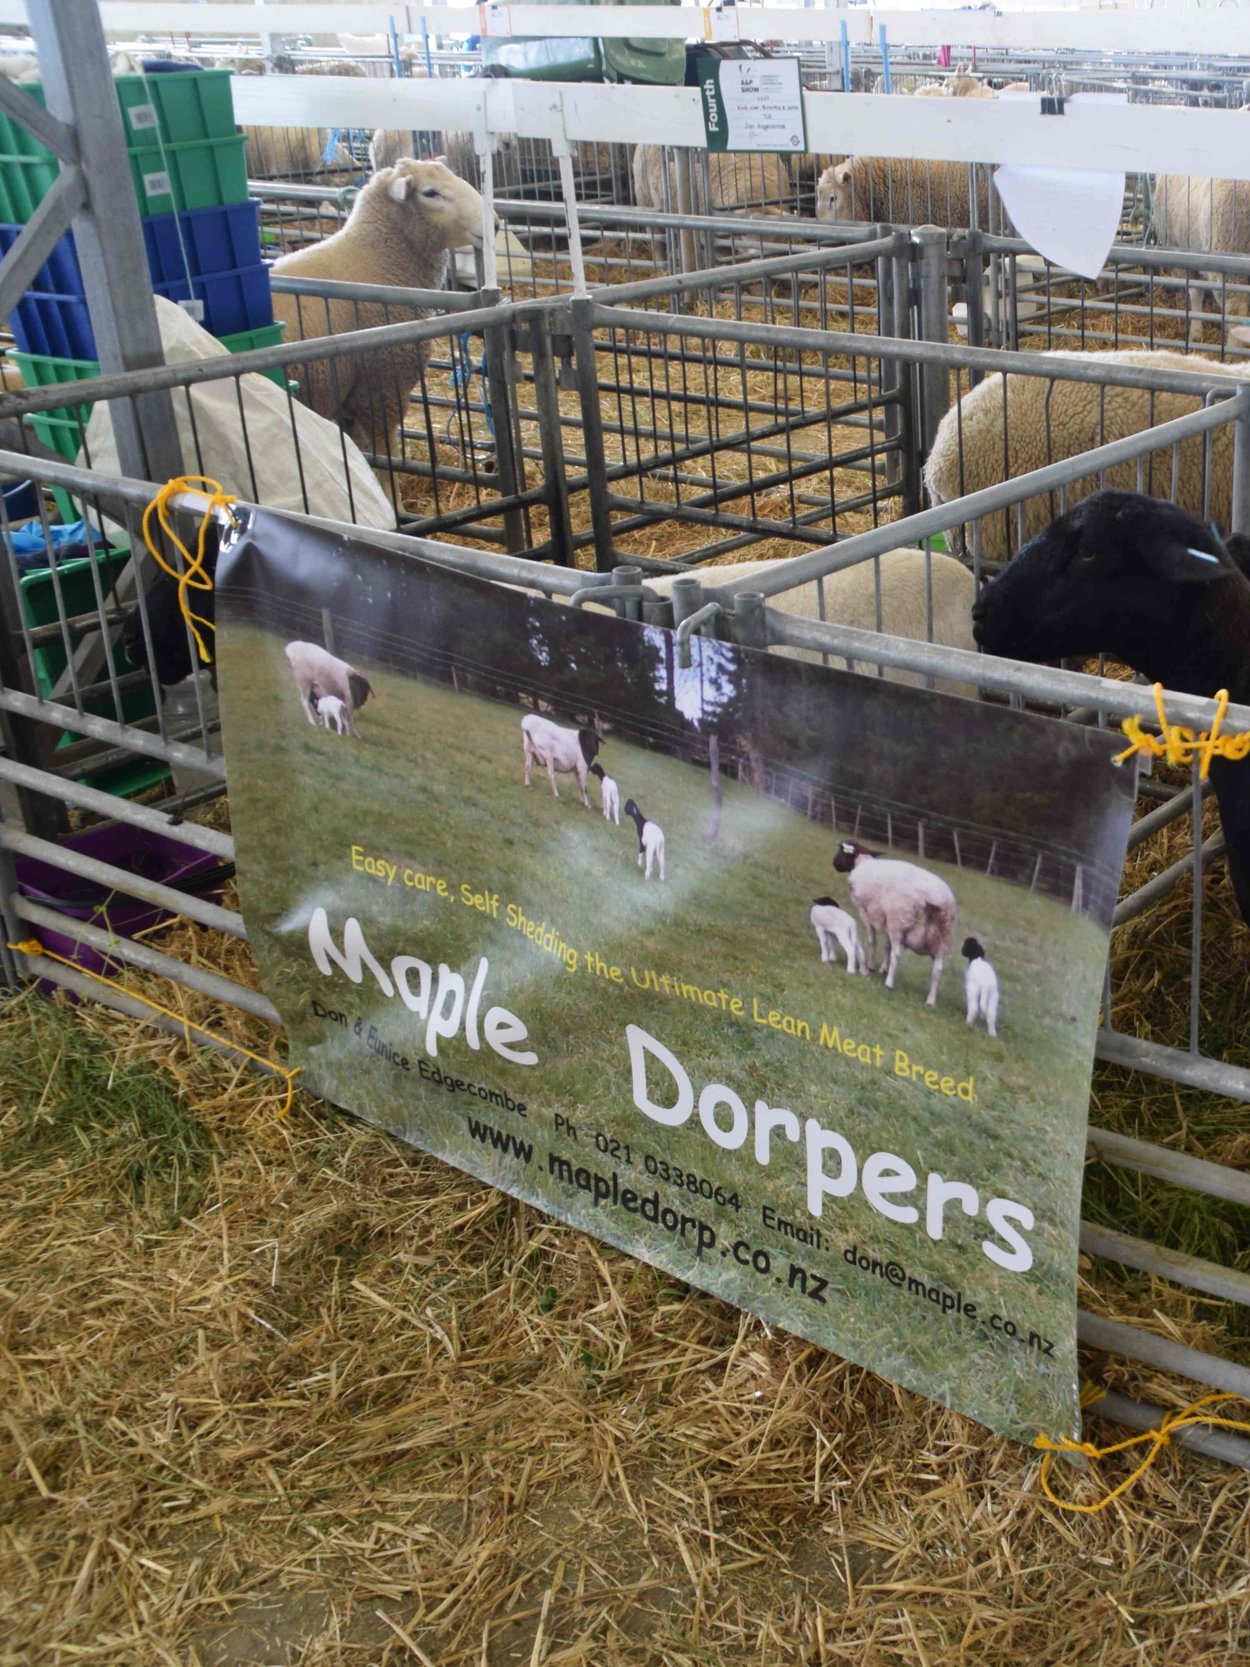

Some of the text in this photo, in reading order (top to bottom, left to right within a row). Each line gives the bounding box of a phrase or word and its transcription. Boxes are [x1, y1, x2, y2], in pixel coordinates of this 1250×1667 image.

[704, 79, 719, 131] Fourth
[308, 906, 1035, 1273] Maple Dorpers
[351, 845, 976, 1102] Easy care, Self Shedding the Ultimate Lean Meat Breed
[311, 1000, 1056, 1358] Don & Eunice Edgecombe Ph 021 0338064 Email: don@maple.co.nz
[467, 1115, 830, 1304] www.mapledorp.co.nz
